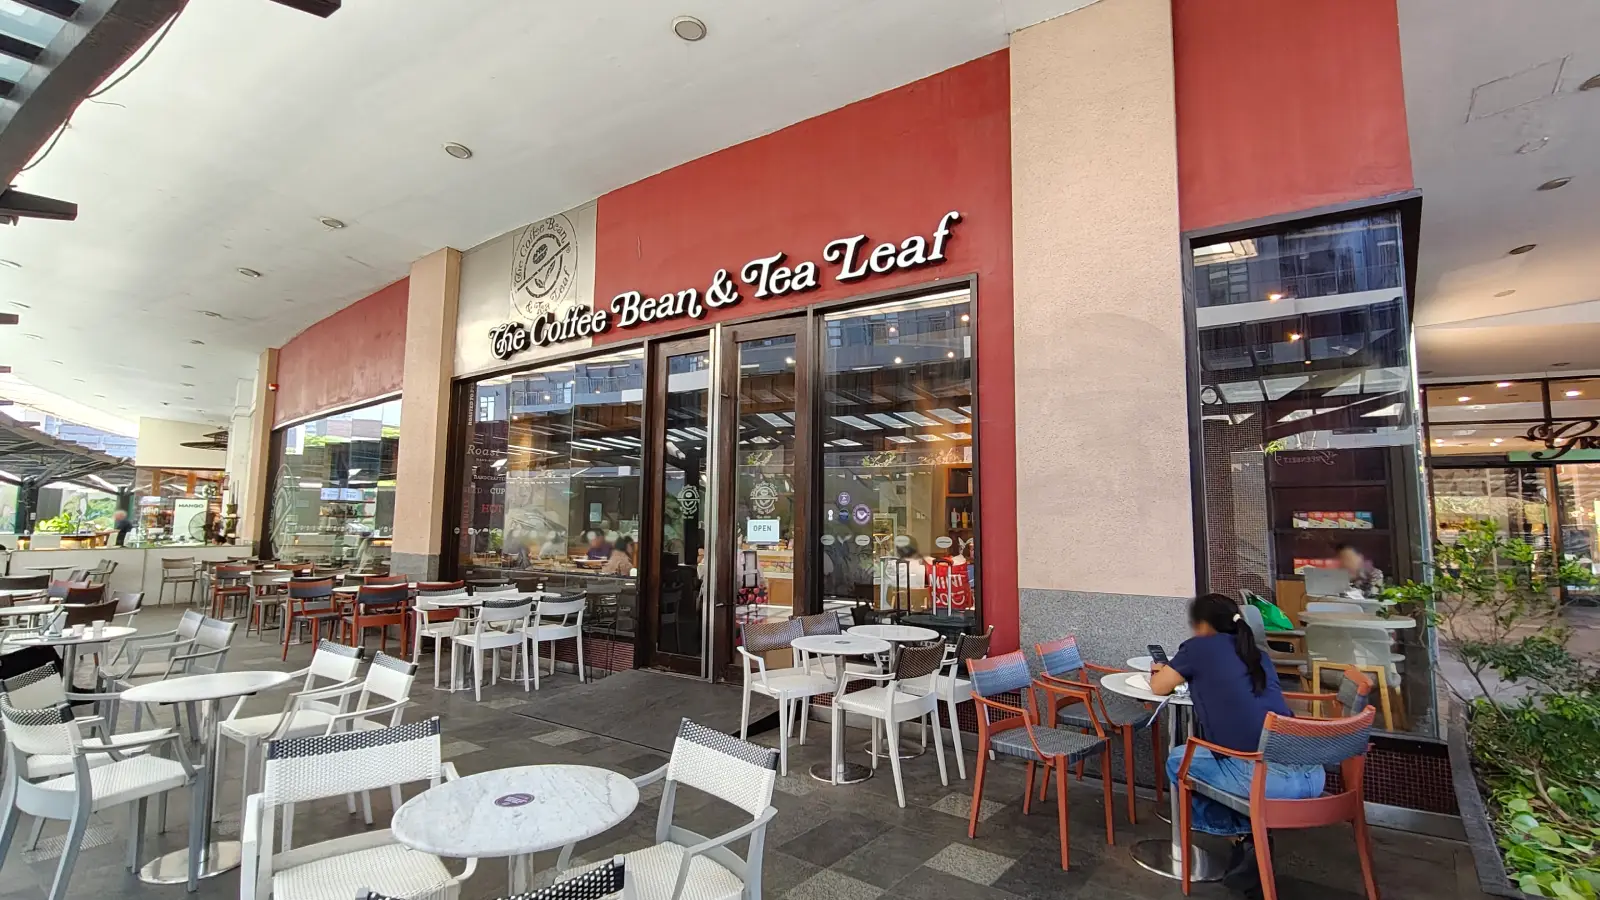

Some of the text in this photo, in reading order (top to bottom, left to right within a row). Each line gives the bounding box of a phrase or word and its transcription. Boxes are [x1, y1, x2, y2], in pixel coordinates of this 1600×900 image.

[513, 217, 568, 284] The Coffee Bean
[489, 211, 960, 360] The Coffee Bean & Tea Leaf
[466, 444, 500, 456] Roast
[490, 487, 506, 495] CUP
